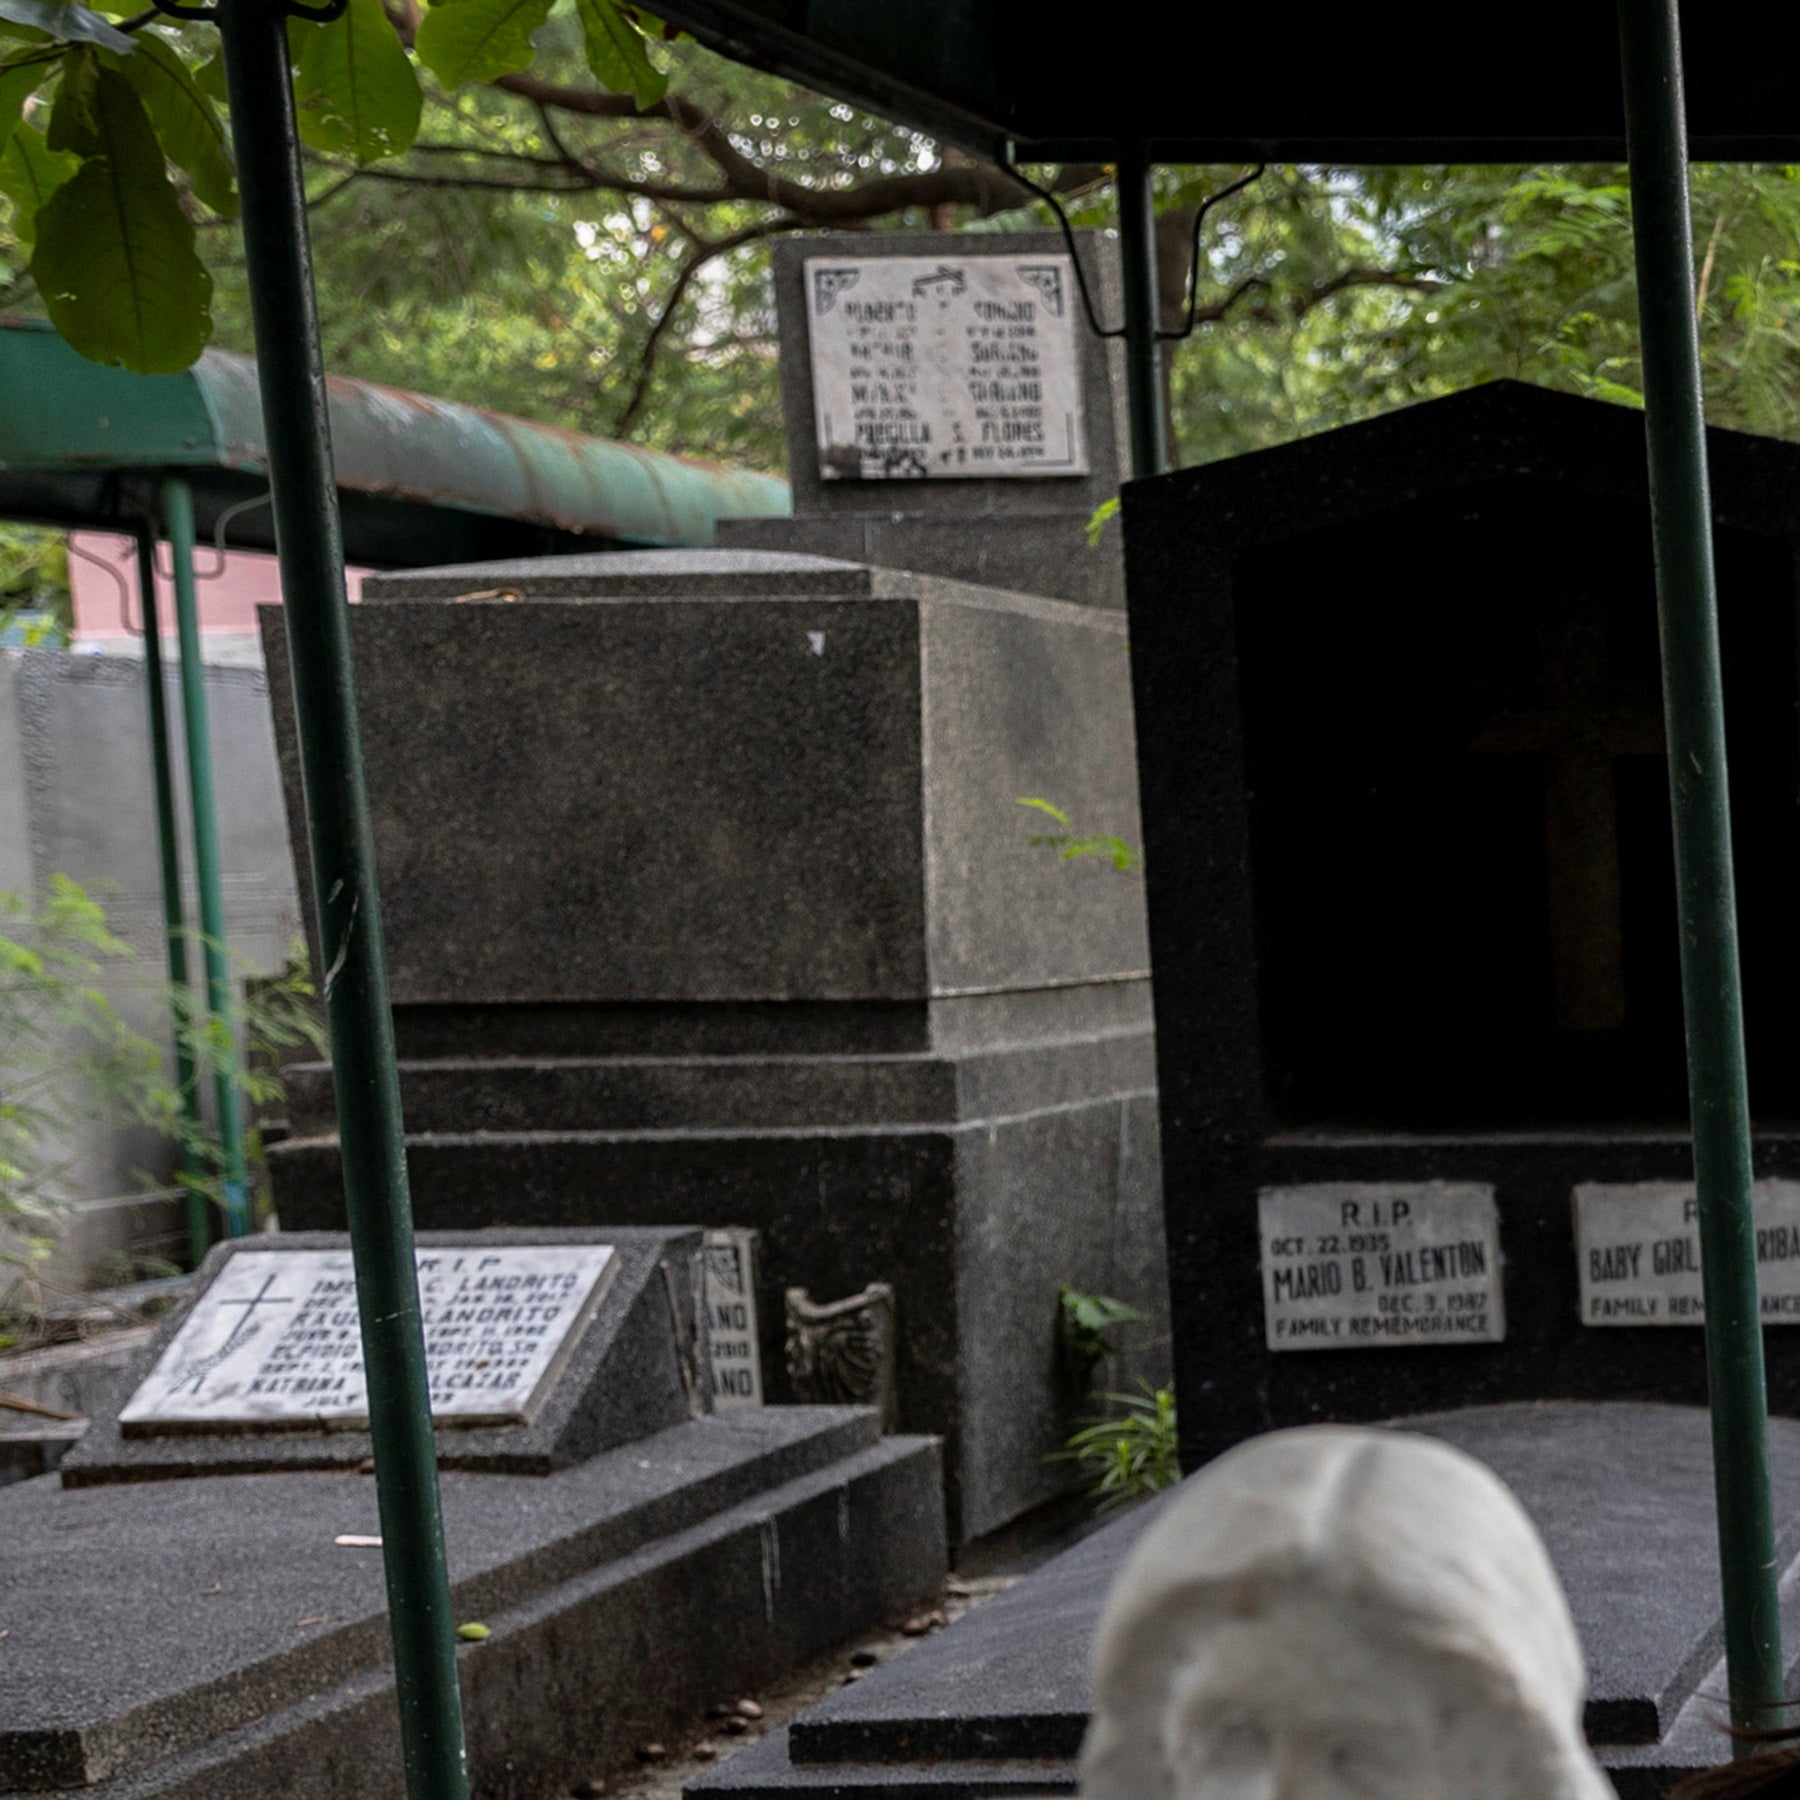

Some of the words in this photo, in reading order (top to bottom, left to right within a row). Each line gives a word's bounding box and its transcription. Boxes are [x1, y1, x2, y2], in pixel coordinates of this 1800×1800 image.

[1589, 1242, 1642, 1282] BABY
[1652, 1238, 1698, 1276] GIRL
[458, 1273, 580, 1292] LANDRITO
[1272, 1262, 1343, 1304] MARIO
[1379, 1241, 1486, 1286] VALENTON
[424, 1306, 561, 1323] LANDRITO
[1591, 1296, 1658, 1316] FAMILY
[1275, 1317, 1343, 1338] FAMILY
[1348, 1312, 1488, 1336] REMEMBRANCE
[246, 1377, 347, 1395] KATRINA
